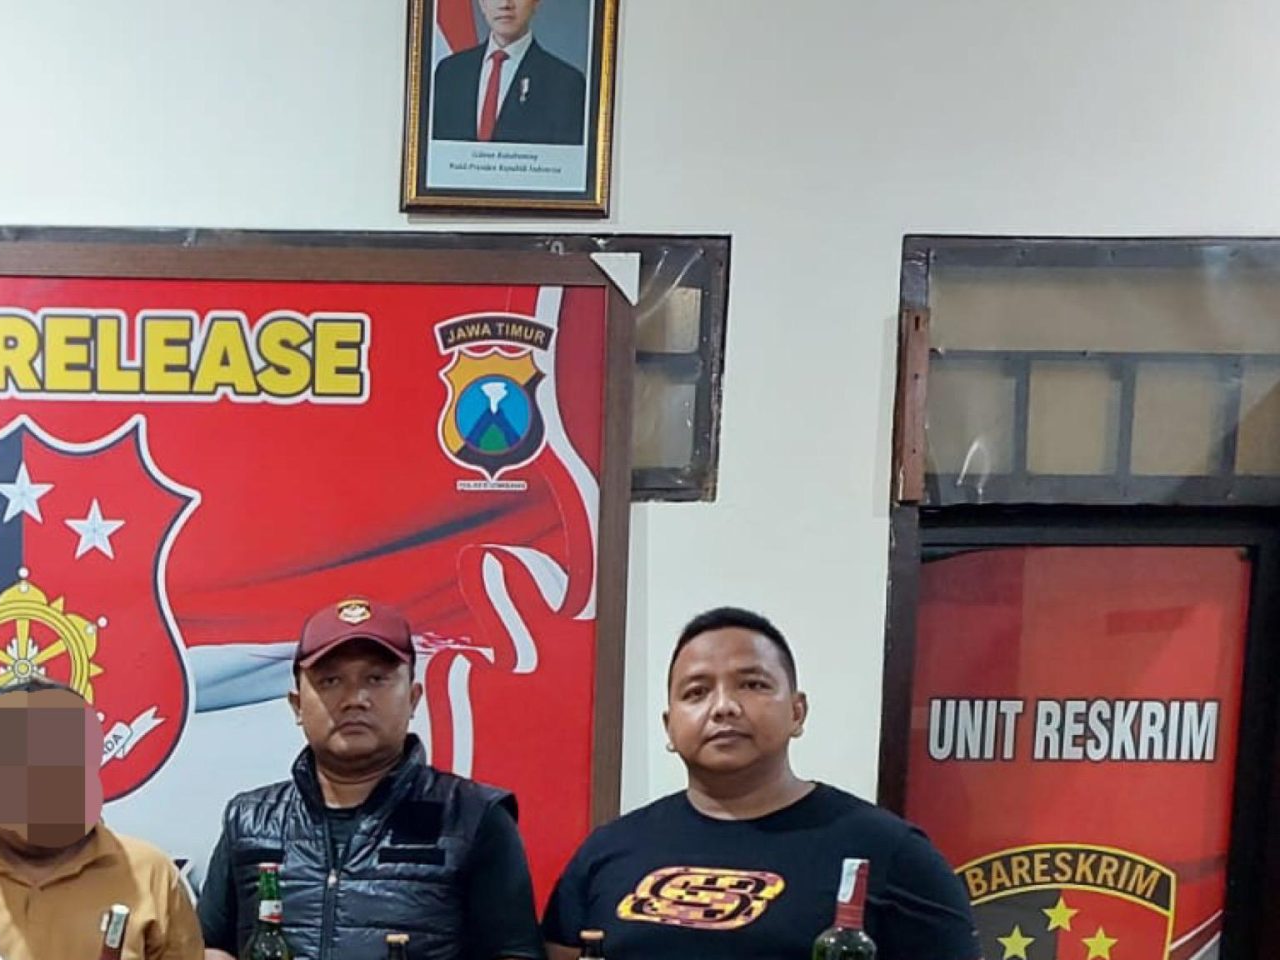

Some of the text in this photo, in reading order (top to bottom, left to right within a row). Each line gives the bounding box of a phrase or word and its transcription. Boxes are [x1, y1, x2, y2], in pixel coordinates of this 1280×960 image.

[447, 322, 546, 345] JAWA TIMUR
[927, 699, 1218, 762] UNIT RESKRIM
[966, 851, 1161, 900] BARESKRIM
